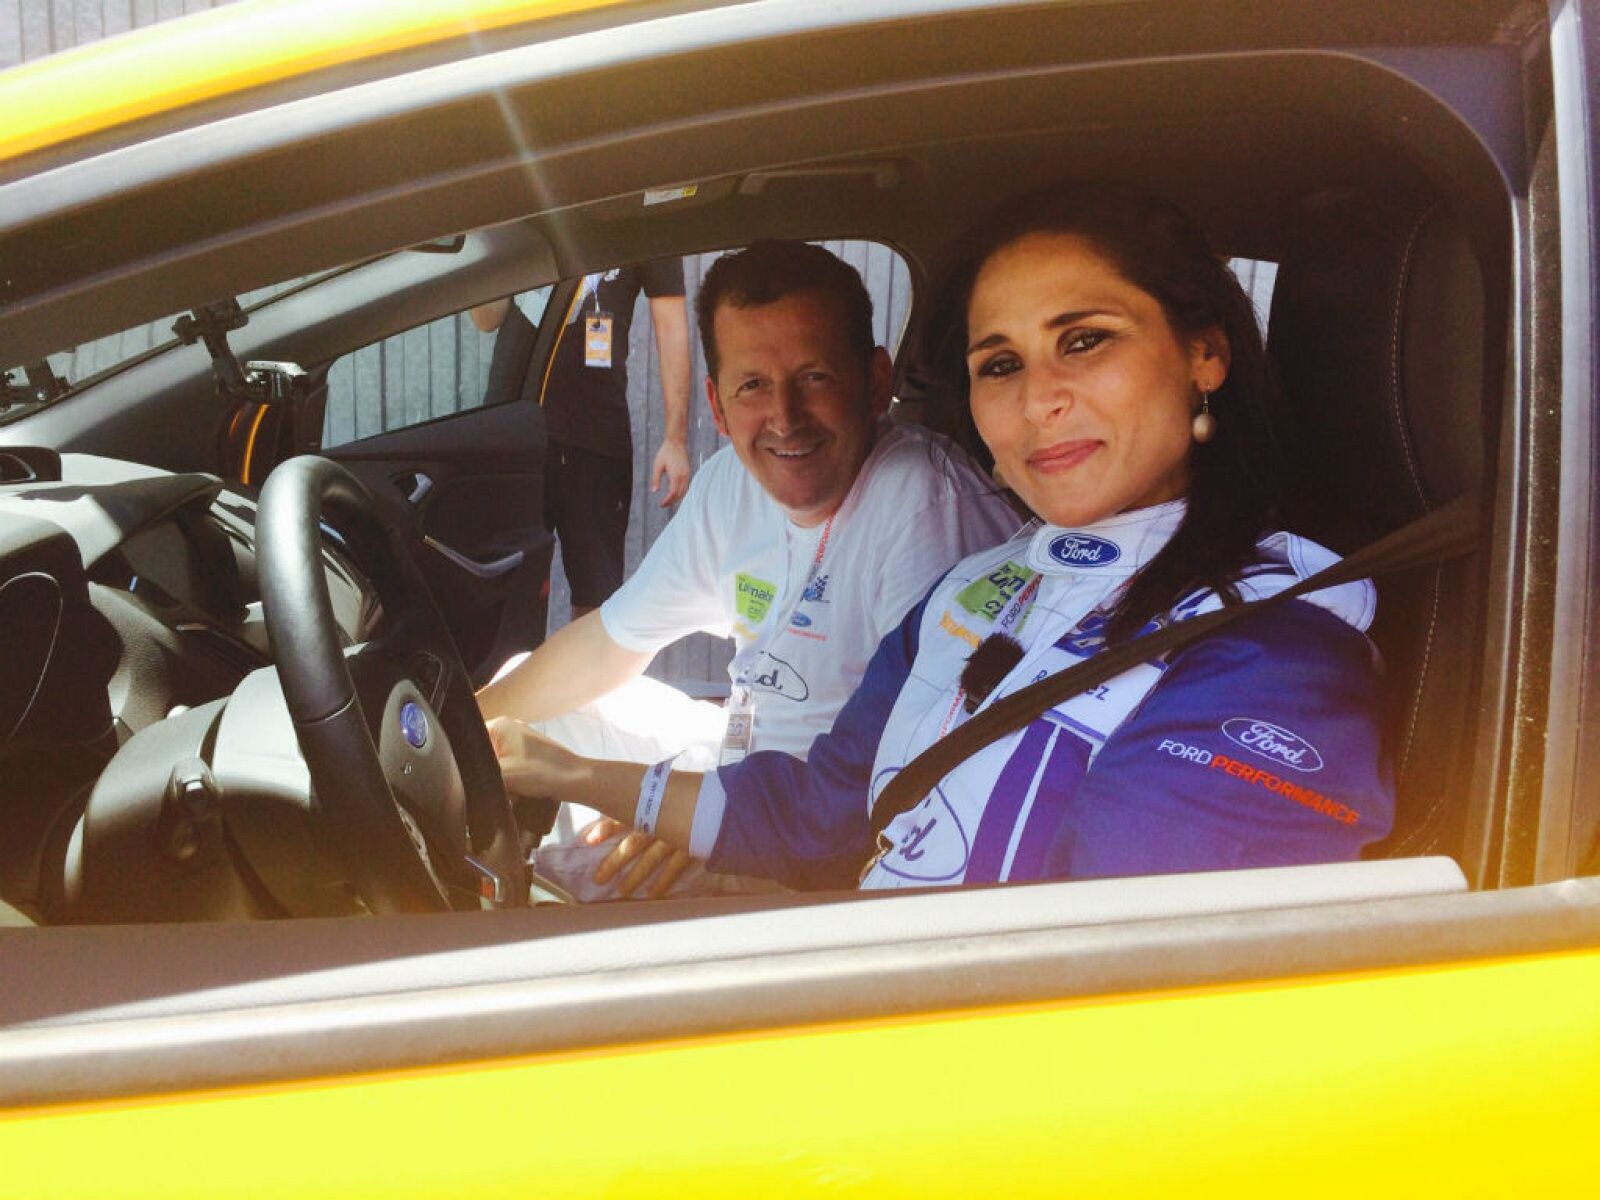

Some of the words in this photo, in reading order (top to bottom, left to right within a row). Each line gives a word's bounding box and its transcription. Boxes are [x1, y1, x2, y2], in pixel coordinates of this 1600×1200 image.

[1061, 537, 1103, 561] Ford
[1240, 721, 1308, 765] Ford
[1156, 738, 1213, 766] FORD
[1210, 754, 1361, 826] PERFORMANCE
